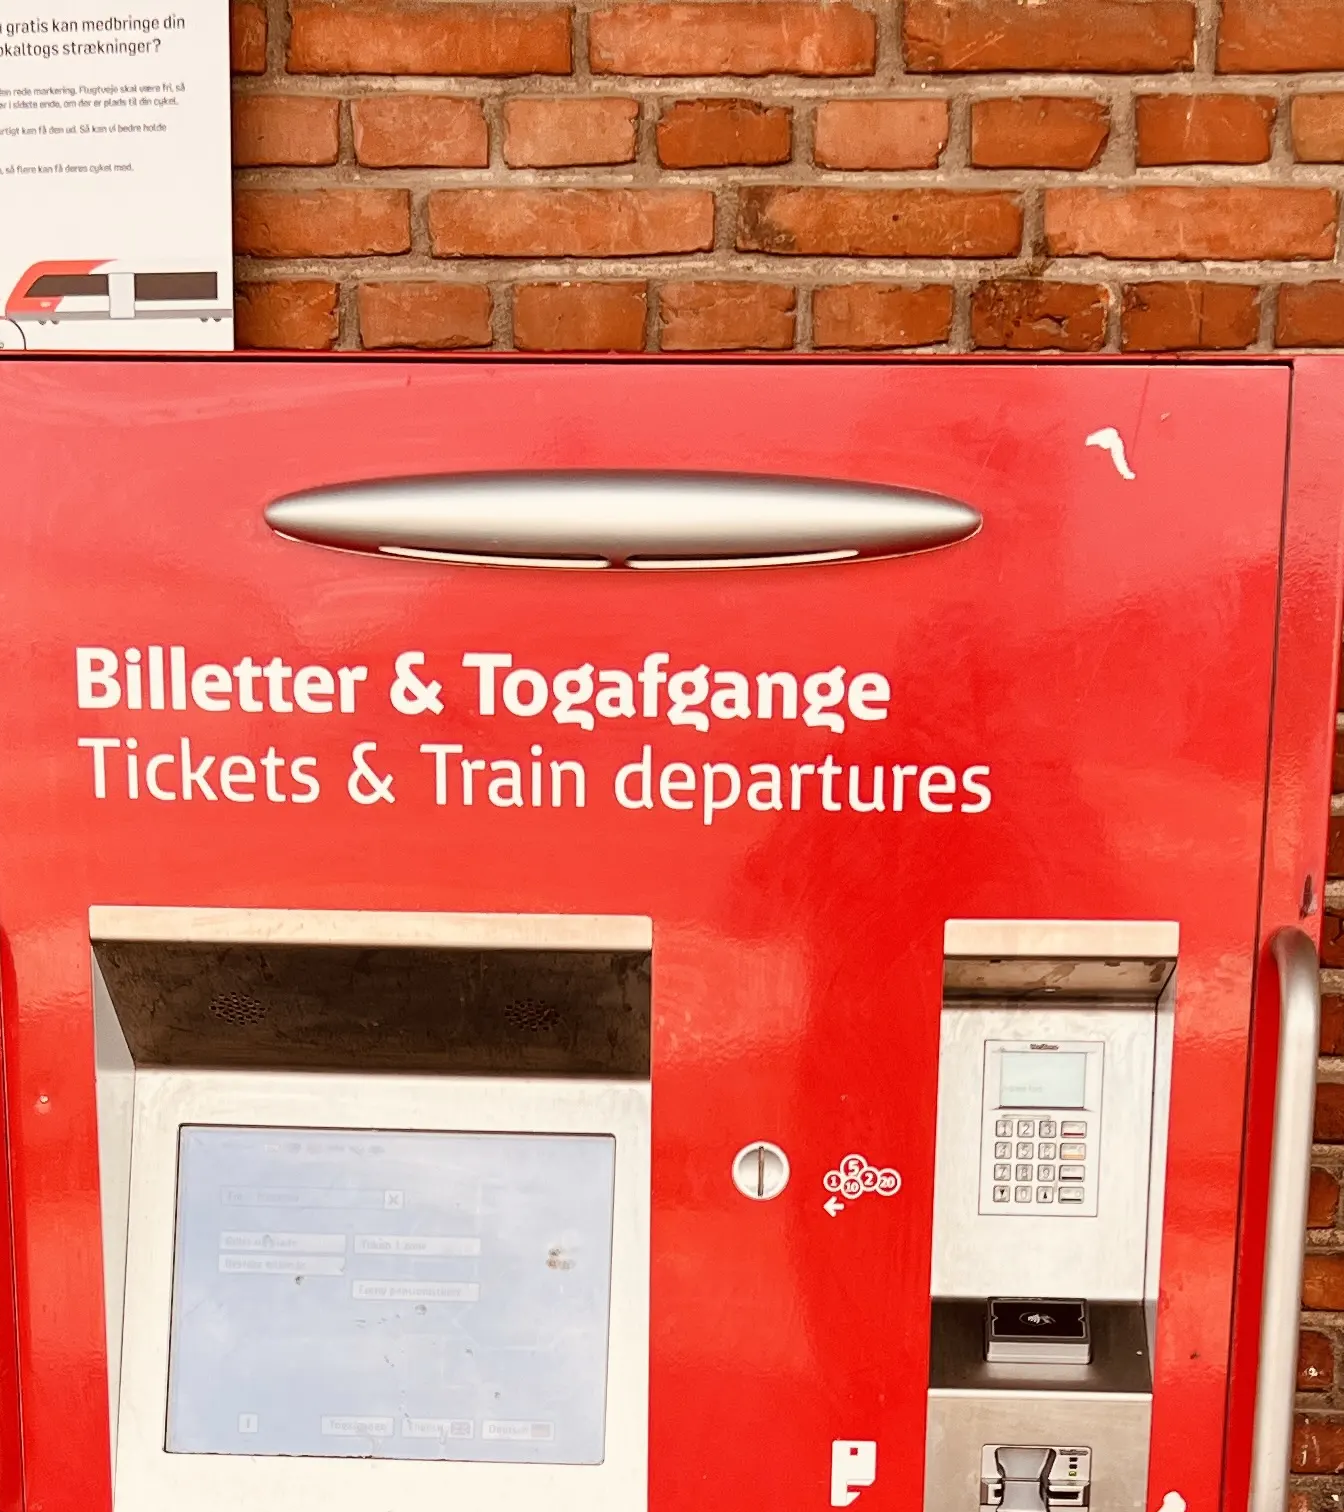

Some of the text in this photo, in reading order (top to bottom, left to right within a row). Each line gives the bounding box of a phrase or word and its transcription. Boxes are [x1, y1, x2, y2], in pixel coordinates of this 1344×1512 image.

[6, 17, 48, 37] gratis
[52, 18, 78, 32] kan
[82, 14, 159, 33] medbringe
[163, 13, 185, 29] din
[62, 37, 161, 56] strækninger?
[76, 645, 892, 734] Billetter & Togafgange
[77, 736, 992, 826] Tickets & Train departures
[847, 1159, 860, 1177] 5
[830, 1175, 838, 1187] 1
[844, 1180, 860, 1193] 10
[864, 1172, 874, 1186] 2
[879, 1175, 896, 1189] 20
